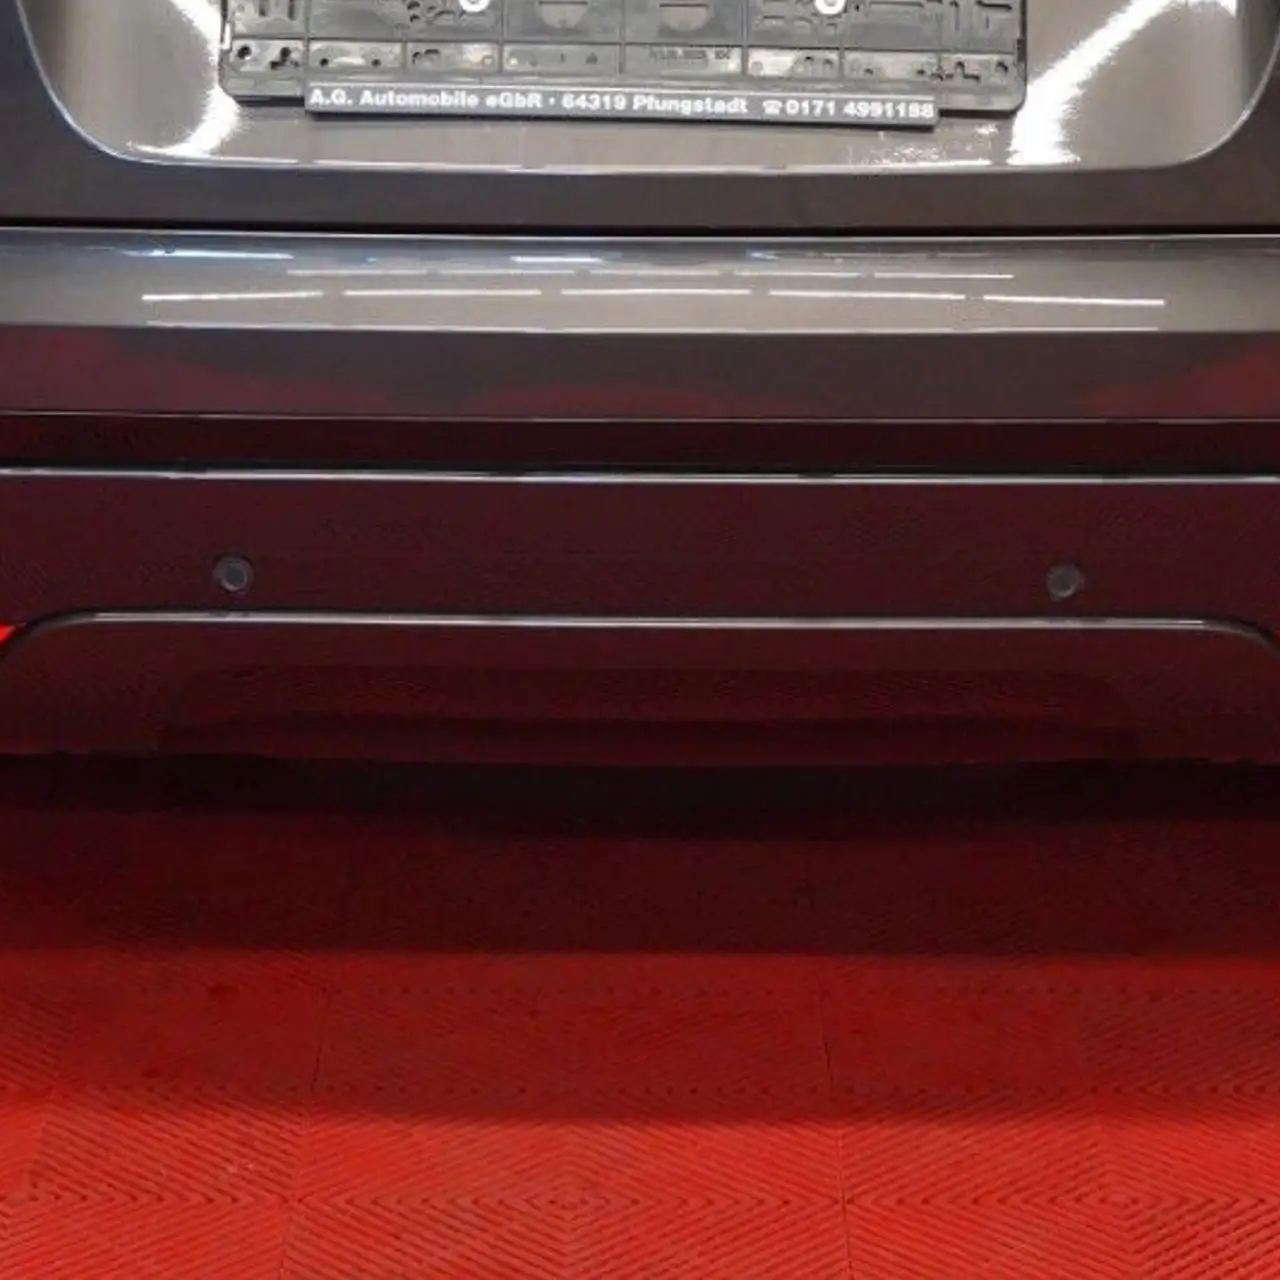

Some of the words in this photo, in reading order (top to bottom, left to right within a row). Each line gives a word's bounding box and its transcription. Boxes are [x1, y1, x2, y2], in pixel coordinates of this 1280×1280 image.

[309, 88, 353, 107] A.G.
[359, 89, 480, 109] Automobile
[484, 91, 543, 109] eGbR
[561, 92, 628, 111] 64319
[631, 94, 748, 115] Pfungstadt
[784, 97, 836, 116] 0171
